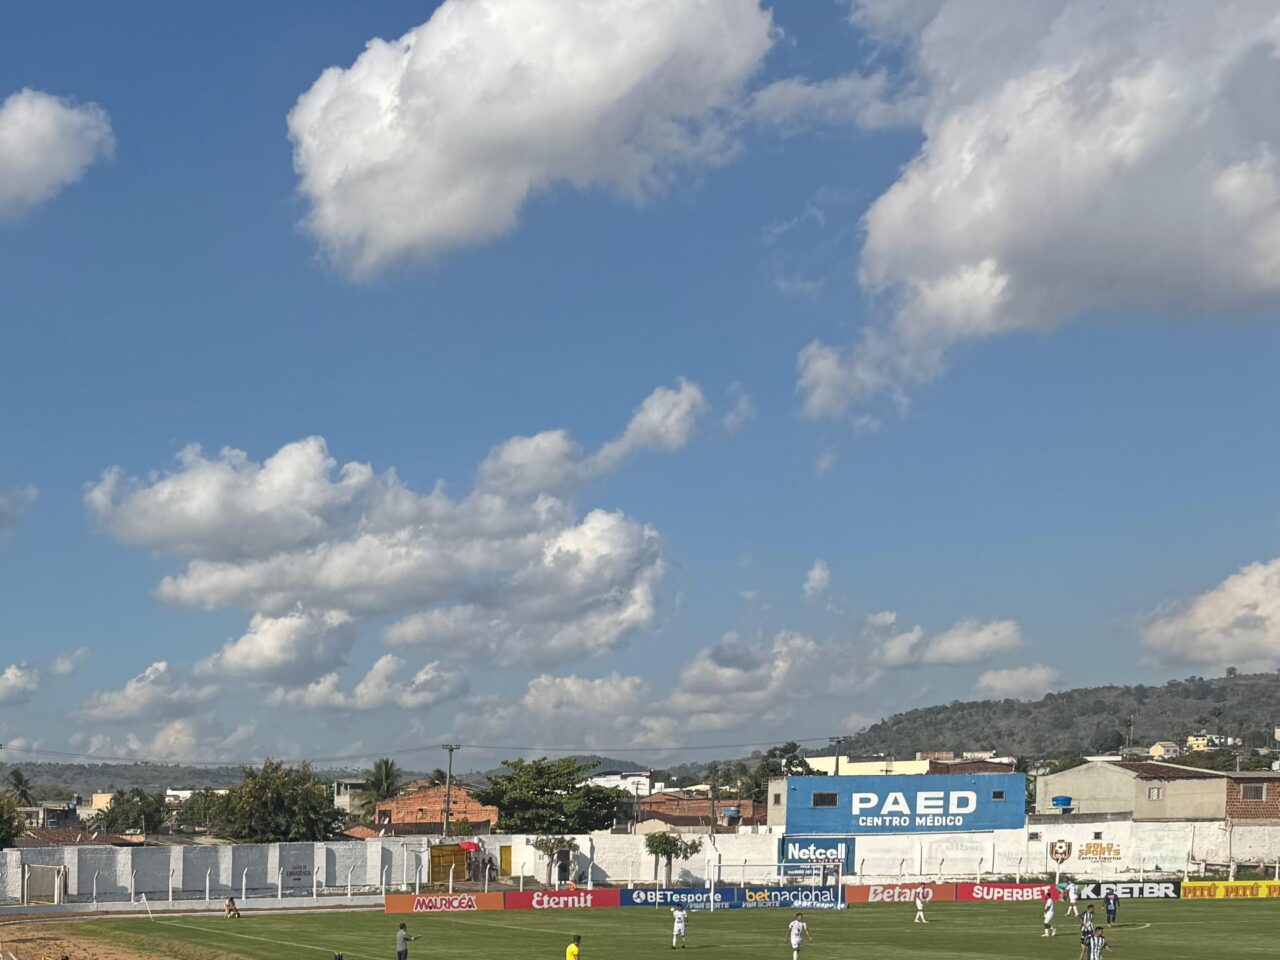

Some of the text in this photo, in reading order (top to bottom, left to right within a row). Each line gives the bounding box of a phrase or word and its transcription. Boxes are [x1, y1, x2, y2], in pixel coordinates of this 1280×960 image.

[851, 790, 977, 816] PAED
[859, 814, 964, 827] CENTRO MÉDICO
[788, 842, 846, 860] Netcell
[1078, 849, 1121, 857] SPORTS
[532, 891, 593, 909] Eternit
[745, 887, 835, 902] betnacional
[972, 885, 1051, 901] SUPERBET
[413, 894, 477, 912] MAURICÉA
